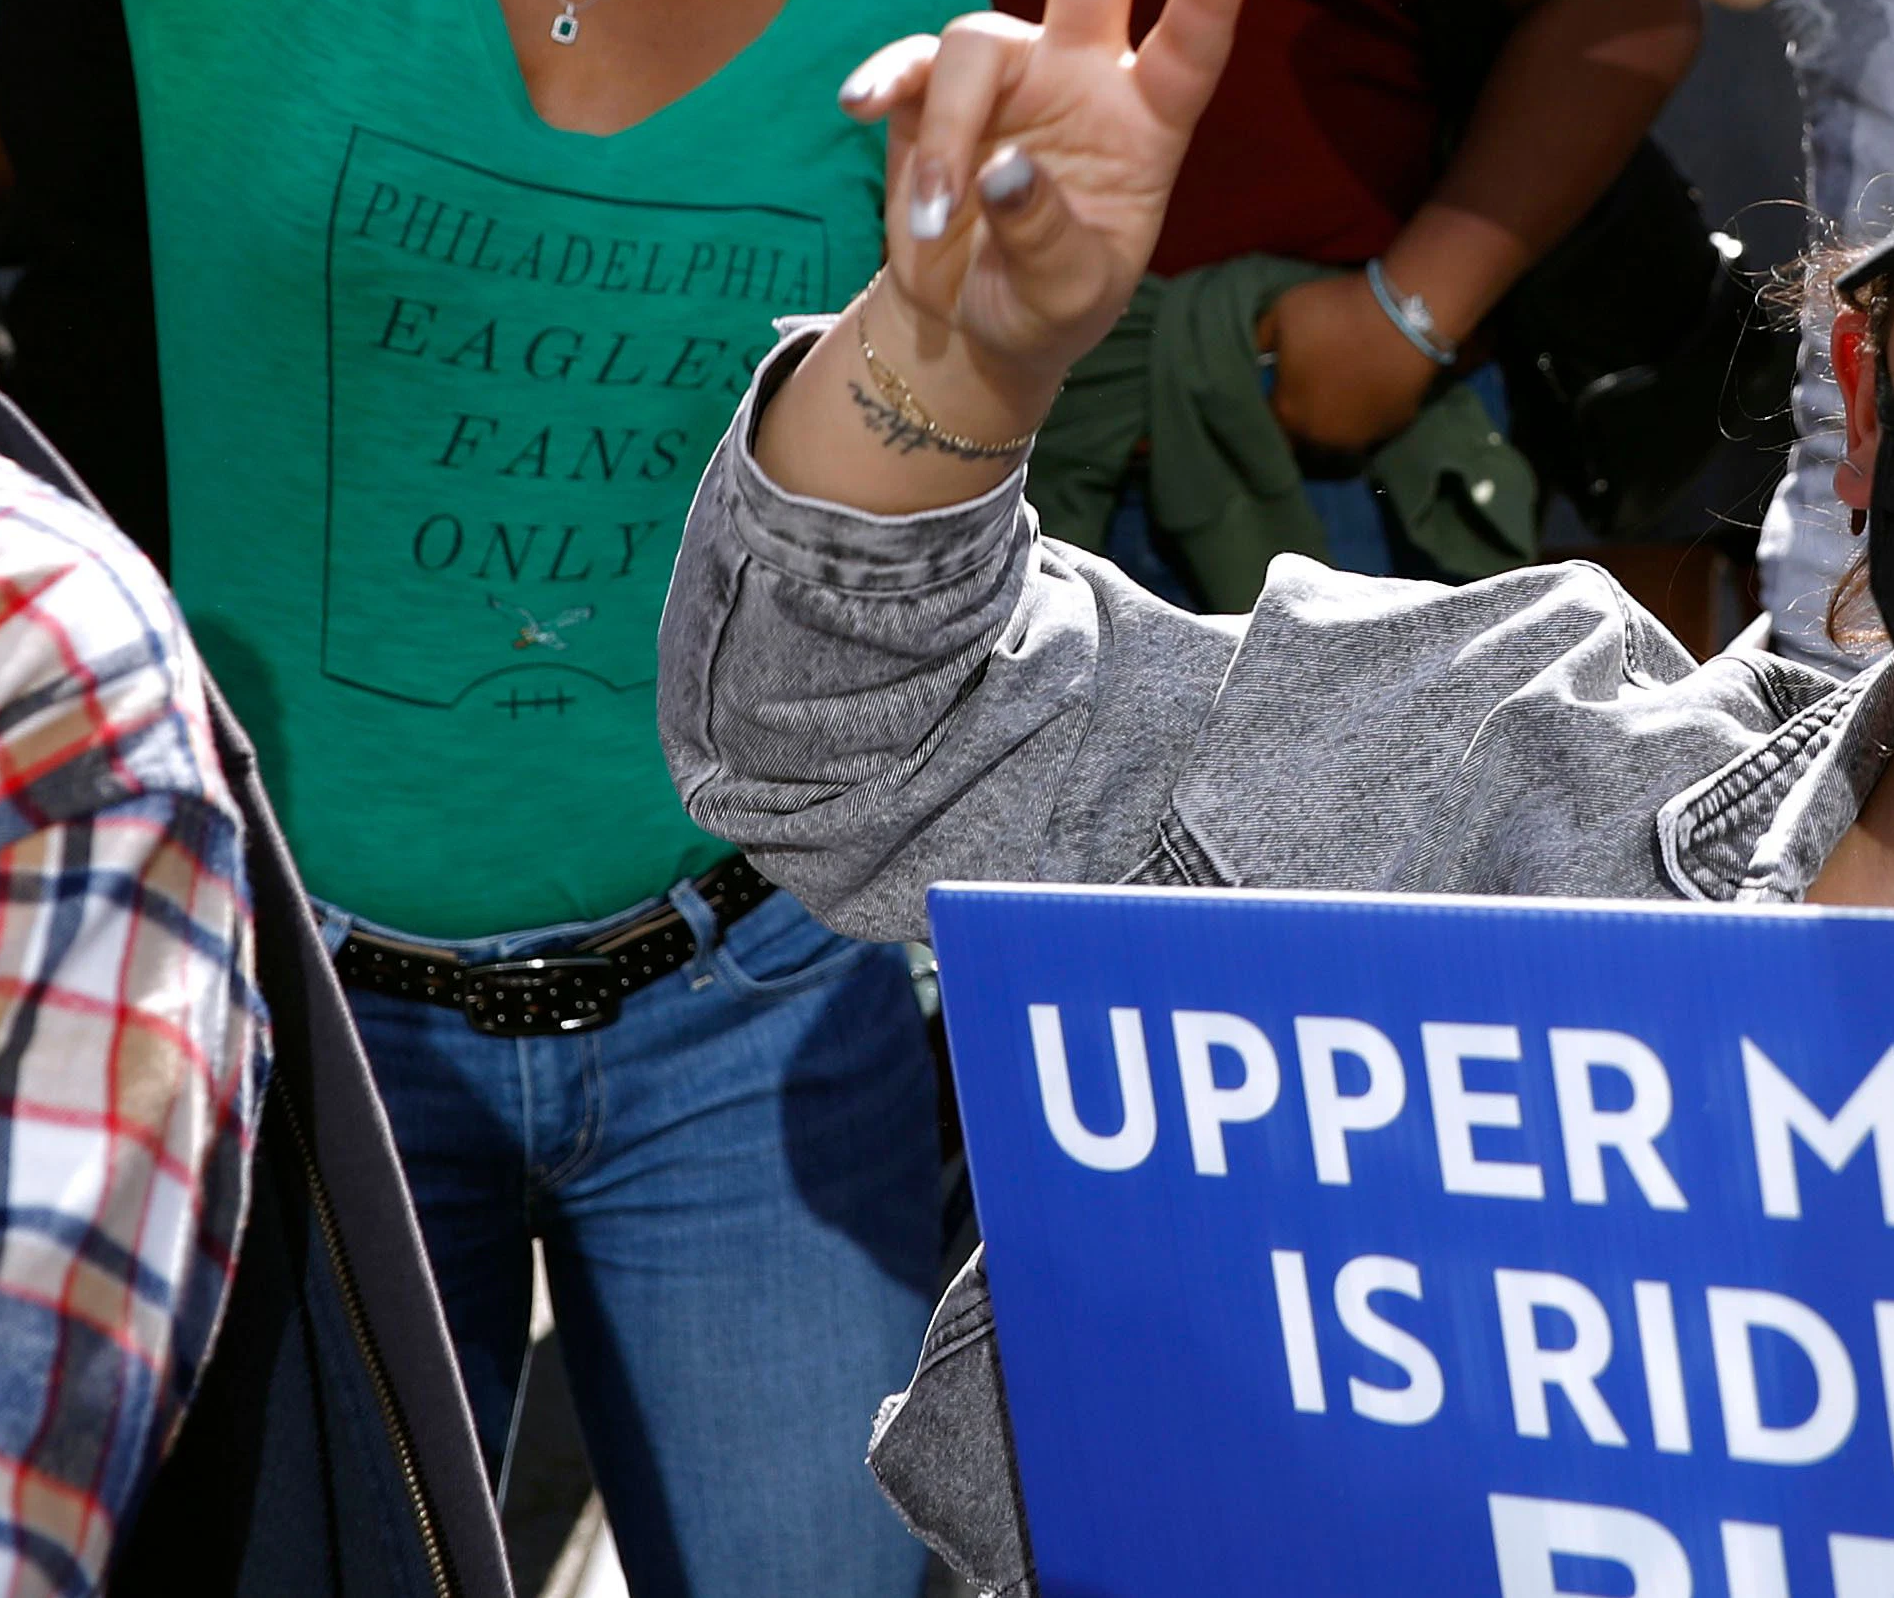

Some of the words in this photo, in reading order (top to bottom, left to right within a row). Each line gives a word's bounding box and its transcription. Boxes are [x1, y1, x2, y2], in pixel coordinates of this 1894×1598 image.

[353, 182, 816, 308] PHILADELPHIA
[372, 295, 770, 398] EAGLES
[432, 412, 690, 482] FANS
[412, 511, 662, 584] ONLY
[1028, 1003, 1688, 1212] UPPER
[1270, 1249, 1446, 1426] IS
